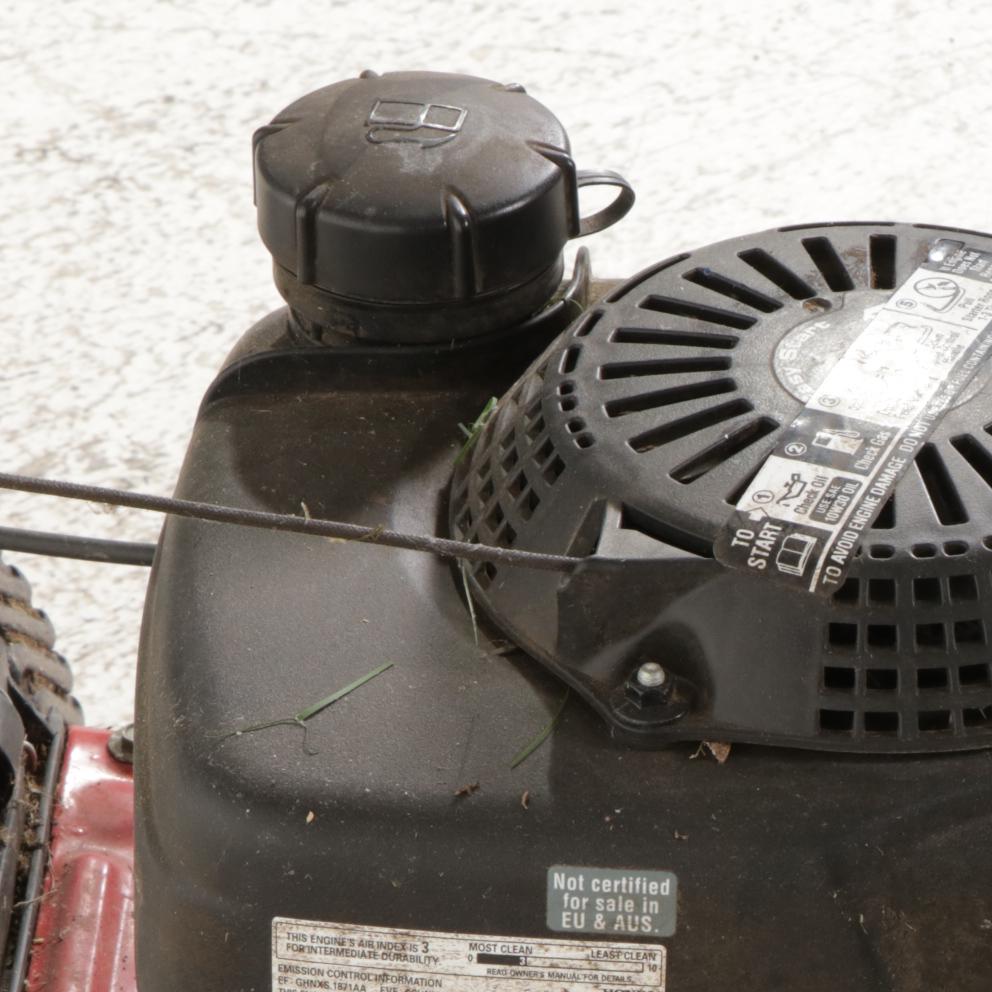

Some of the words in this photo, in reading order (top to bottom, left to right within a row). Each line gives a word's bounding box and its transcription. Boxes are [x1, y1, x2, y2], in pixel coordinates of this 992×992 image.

[908, 421, 931, 439] NOT
[854, 446, 880, 470] Check
[870, 431, 891, 446] Gas
[899, 437, 918, 452] DO
[871, 457, 906, 499] DAMAGE
[794, 488, 816, 514] Check
[816, 498, 832, 513] USE
[826, 475, 842, 492] SAE
[825, 496, 850, 521] 10W30
[844, 483, 858, 498] OIL
[849, 498, 880, 531] ENGINE
[731, 529, 754, 547] TO
[747, 522, 783, 570] START
[831, 530, 860, 565] AVOID
[823, 565, 842, 585] TO
[553, 872, 585, 891] Not
[591, 876, 671, 896] certified
[563, 892, 589, 911] for
[595, 895, 635, 913] sale
[642, 896, 660, 915] in
[562, 912, 585, 929] EU
[593, 913, 606, 930] &
[613, 914, 659, 933] AUS.
[286, 932, 308, 943] THIS
[310, 935, 355, 948] ENGINE'S
[357, 939, 376, 949] AIR
[376, 940, 407, 952] INDEX
[409, 943, 419, 953] IS
[421, 941, 430, 954] 3
[286, 942, 306, 953] FOR
[307, 944, 379, 960] INTERMEDIATE
[468, 942, 498, 953] MOST
[500, 944, 533, 955] CLEAN
[467, 954, 474, 963] 0
[519, 956, 527, 966] 3
[590, 950, 621, 960] LEAST
[624, 950, 658, 962] CLEAN
[278, 963, 325, 977] EMISSION
[326, 968, 375, 983] CONTROL
[375, 972, 443, 989] INFORMATION
[486, 967, 508, 976] READ
[547, 971, 581, 981] MANUAL
[584, 972, 599, 982] FOR
